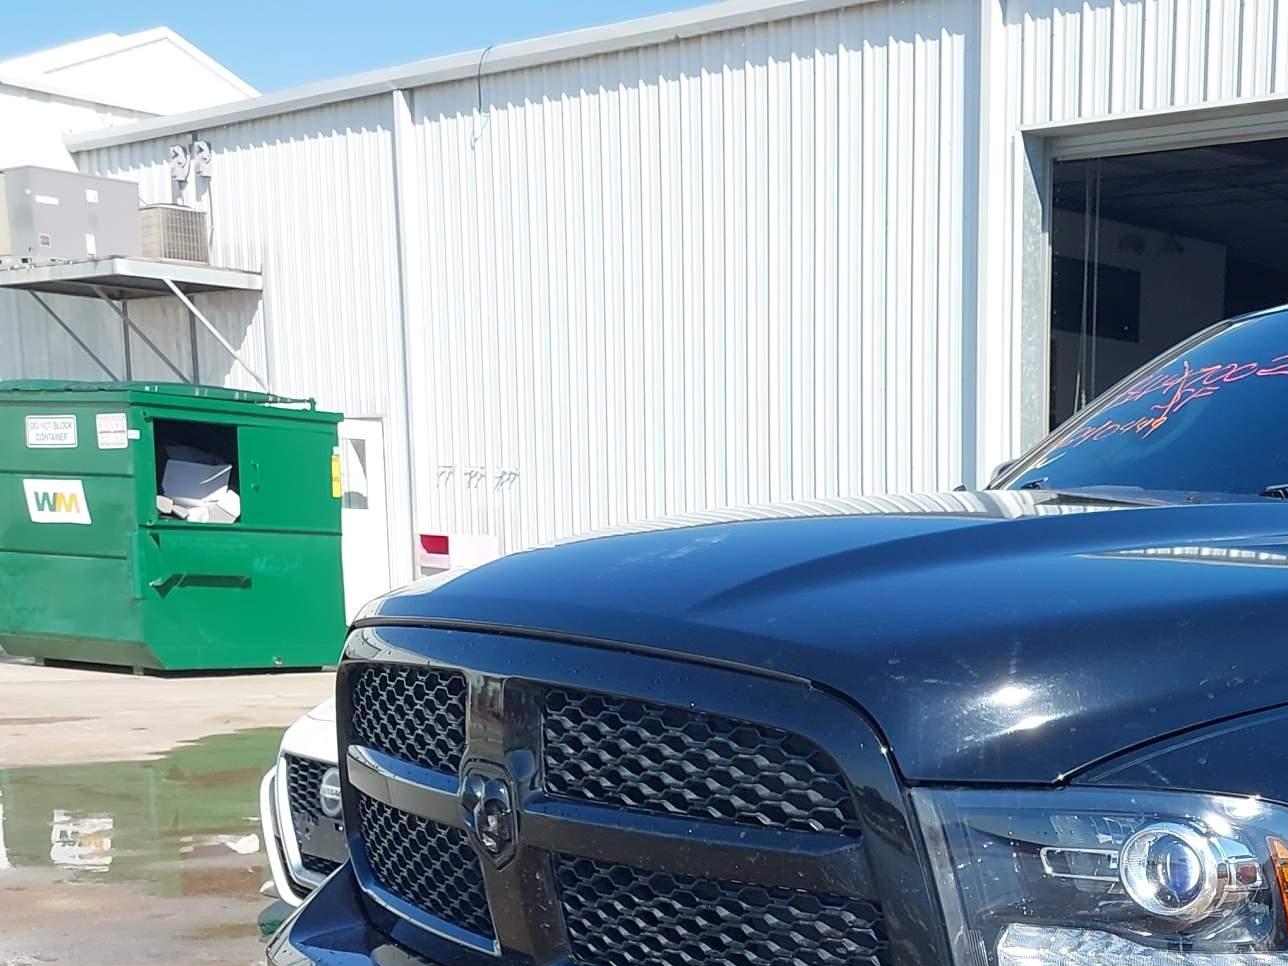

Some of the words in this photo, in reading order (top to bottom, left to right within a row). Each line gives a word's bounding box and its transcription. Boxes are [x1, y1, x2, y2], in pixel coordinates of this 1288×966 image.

[30, 422, 39, 430] DO
[40, 422, 52, 430] NOT
[53, 421, 73, 430] BLOCK
[36, 432, 68, 441] CONTAINER
[33, 491, 80, 513] WM
